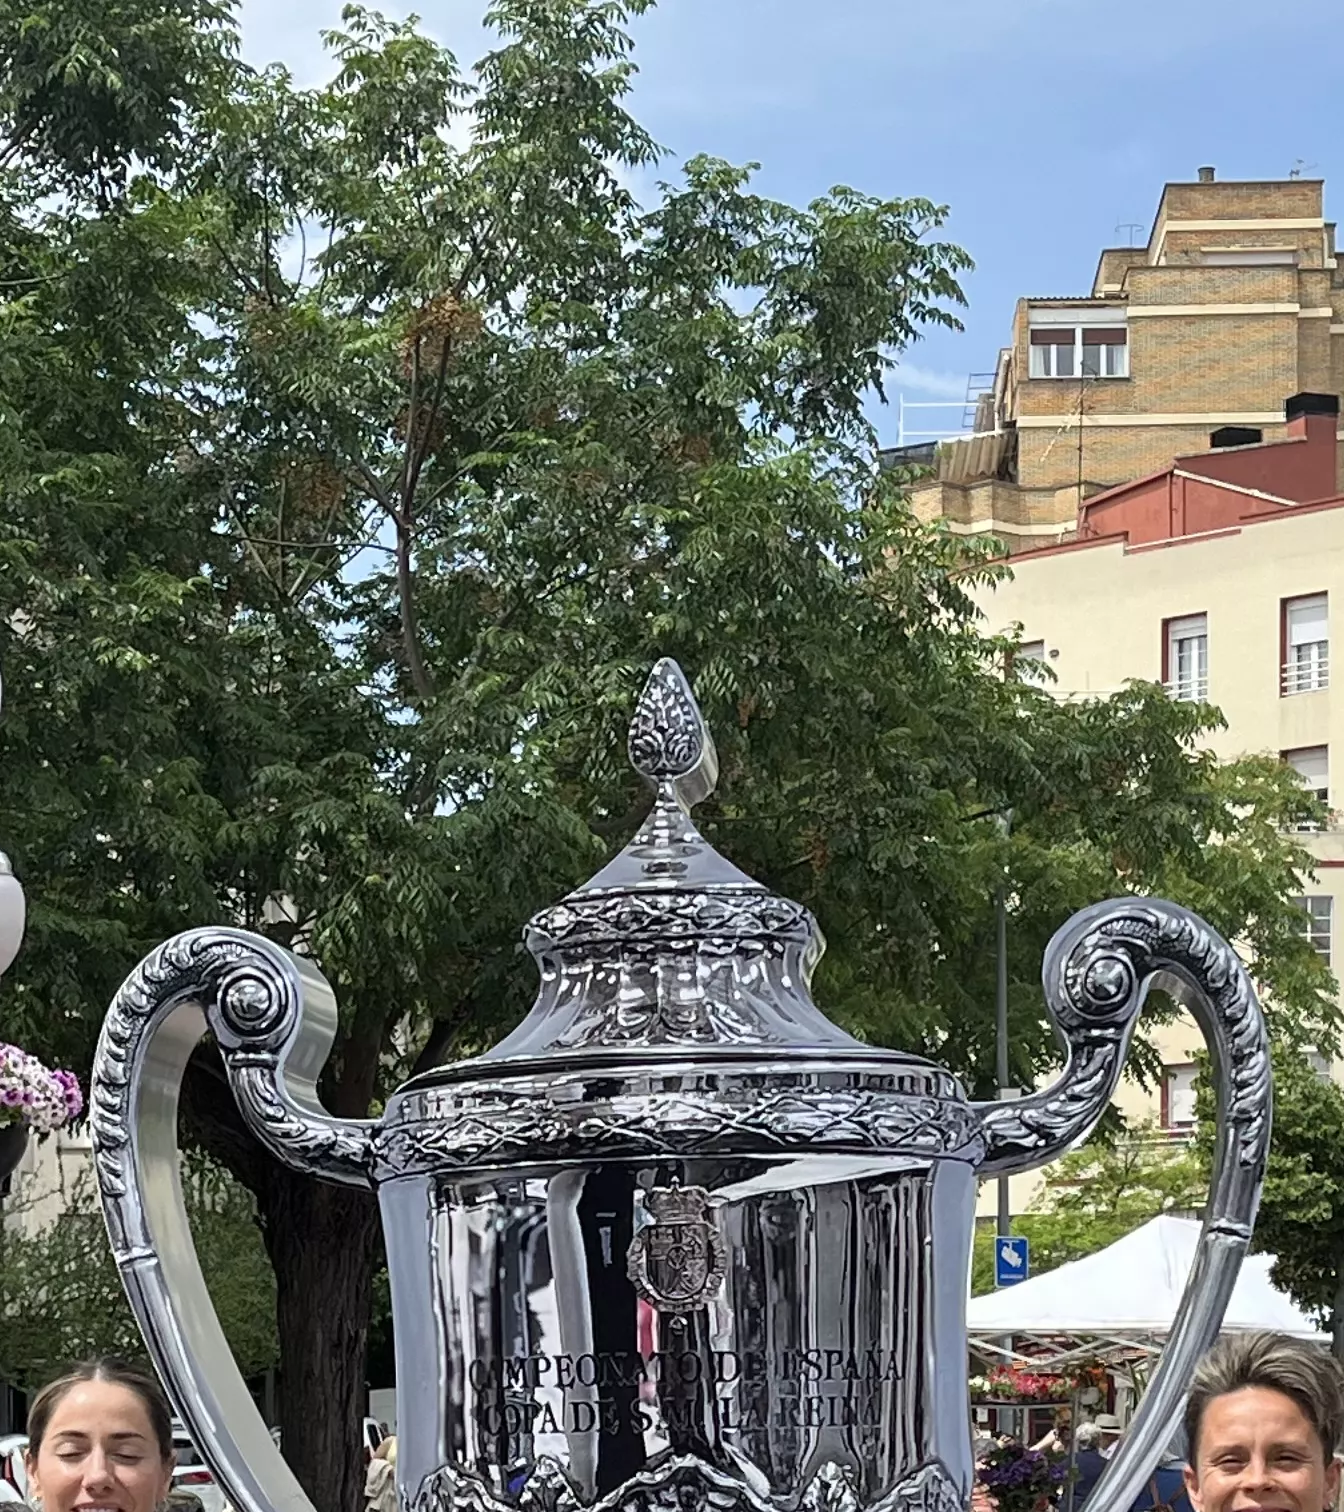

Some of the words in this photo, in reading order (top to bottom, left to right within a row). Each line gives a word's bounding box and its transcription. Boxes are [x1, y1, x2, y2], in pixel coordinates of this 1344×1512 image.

[469, 1350, 702, 1393] CAMPEONATO
[712, 1350, 767, 1383] DE
[484, 1400, 564, 1437] COPA
[569, 1398, 620, 1435] DE
[720, 1396, 768, 1433] LA
[778, 1395, 882, 1428] REINA
